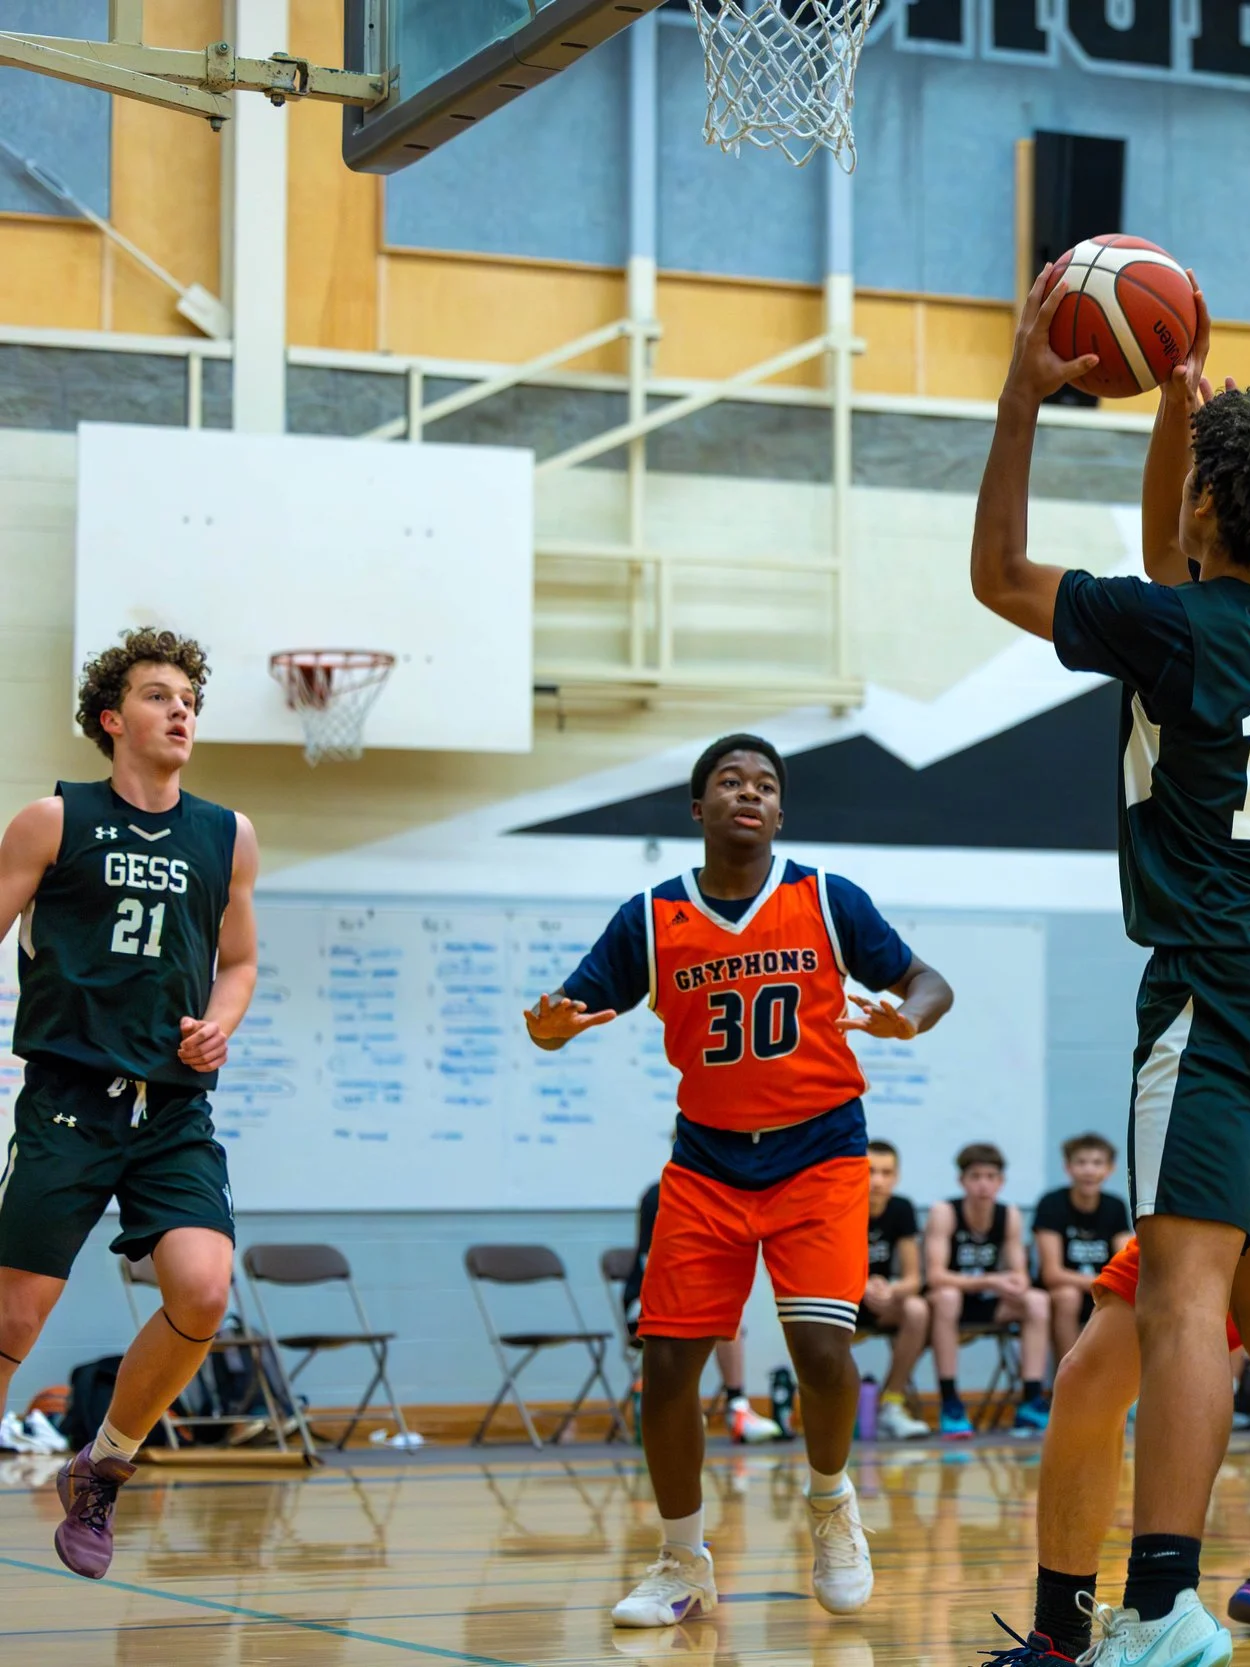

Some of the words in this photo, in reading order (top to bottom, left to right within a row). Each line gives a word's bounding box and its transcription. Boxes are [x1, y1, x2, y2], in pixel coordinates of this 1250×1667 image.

[104, 852, 189, 894] GESS
[110, 897, 166, 958] 21
[673, 948, 818, 992] GRYPHONS
[702, 982, 801, 1067] 30
